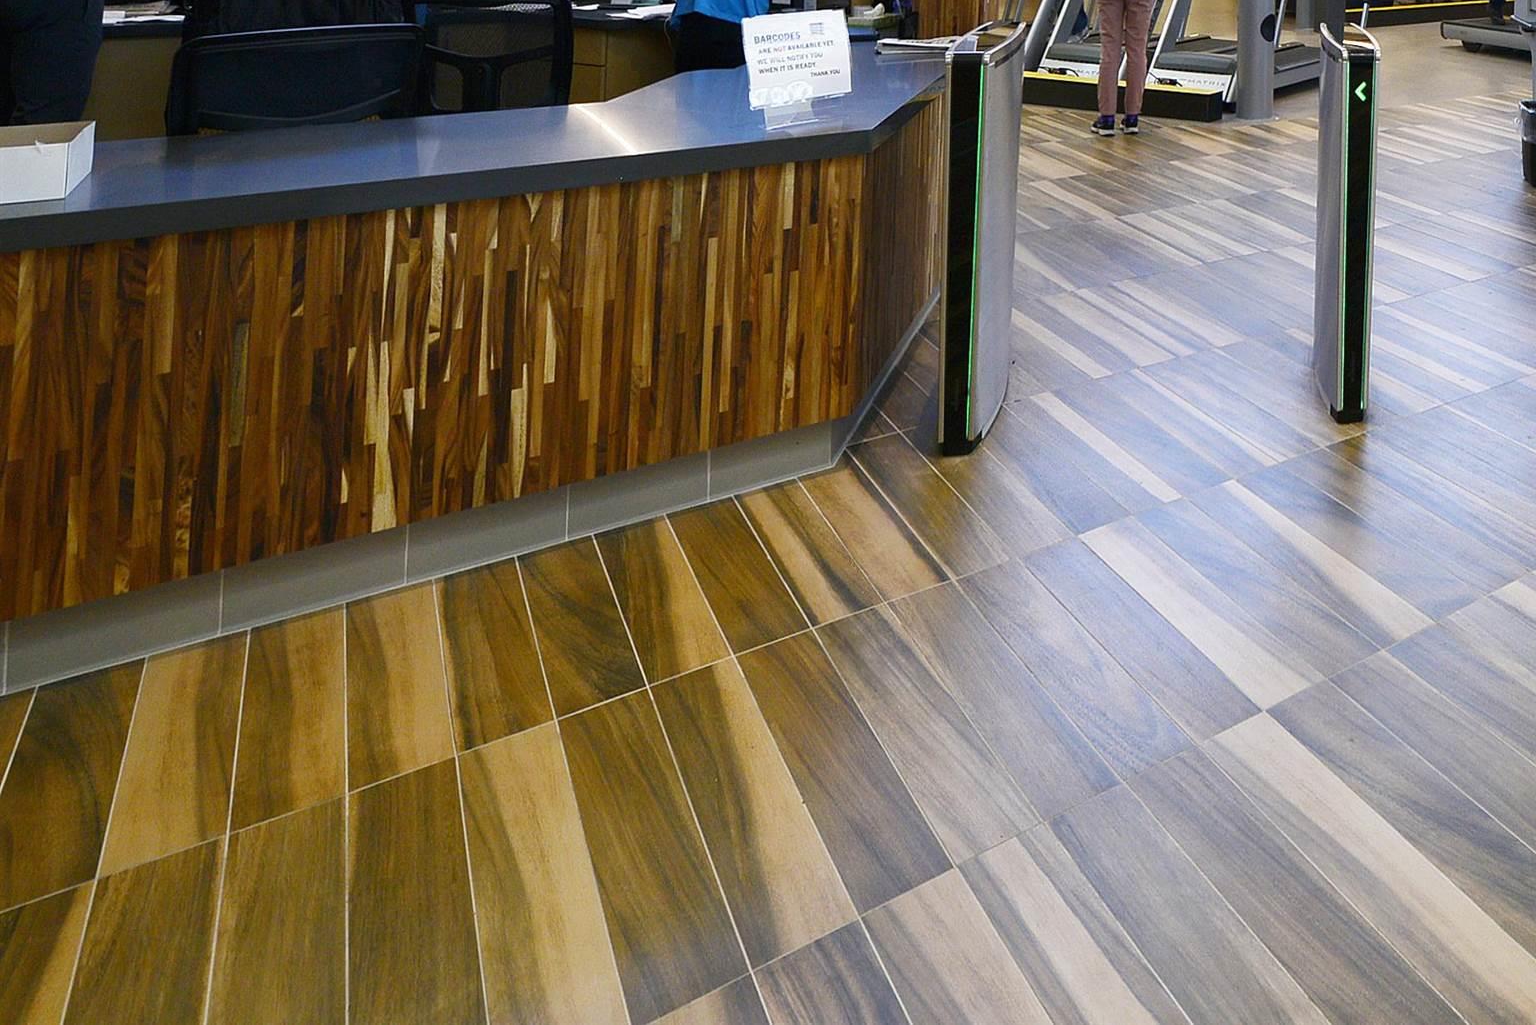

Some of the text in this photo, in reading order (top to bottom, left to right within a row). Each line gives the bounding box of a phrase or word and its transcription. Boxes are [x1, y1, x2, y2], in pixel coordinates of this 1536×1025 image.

[754, 31, 801, 45] BARCODES
[787, 42, 821, 51] AVAILABLE
[787, 54, 809, 62] NOTIFY
[758, 66, 778, 74] WHEN
[795, 62, 816, 70] READY
